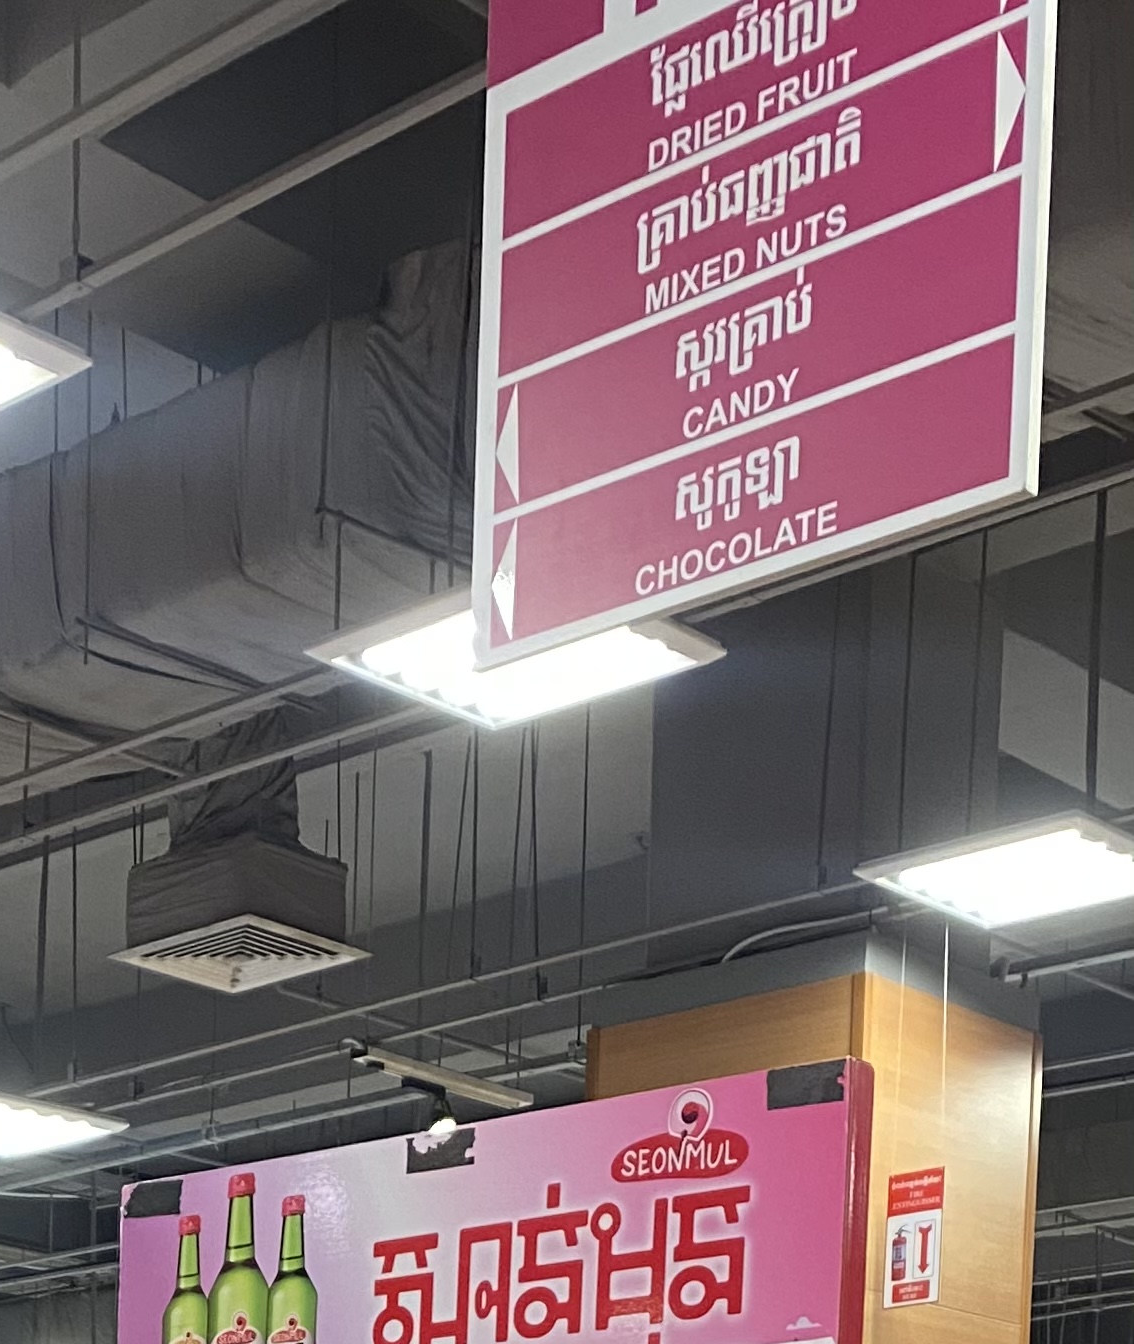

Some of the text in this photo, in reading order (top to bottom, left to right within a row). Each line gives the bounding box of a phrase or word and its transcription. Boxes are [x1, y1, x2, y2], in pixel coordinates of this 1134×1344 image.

[648, 49, 858, 172] DRIED FRUIT
[645, 205, 848, 315] MIXED NUTS
[682, 367, 800, 439] CANDY
[636, 501, 839, 596] CHOCOLATE
[620, 1137, 738, 1179] SEONMUL
